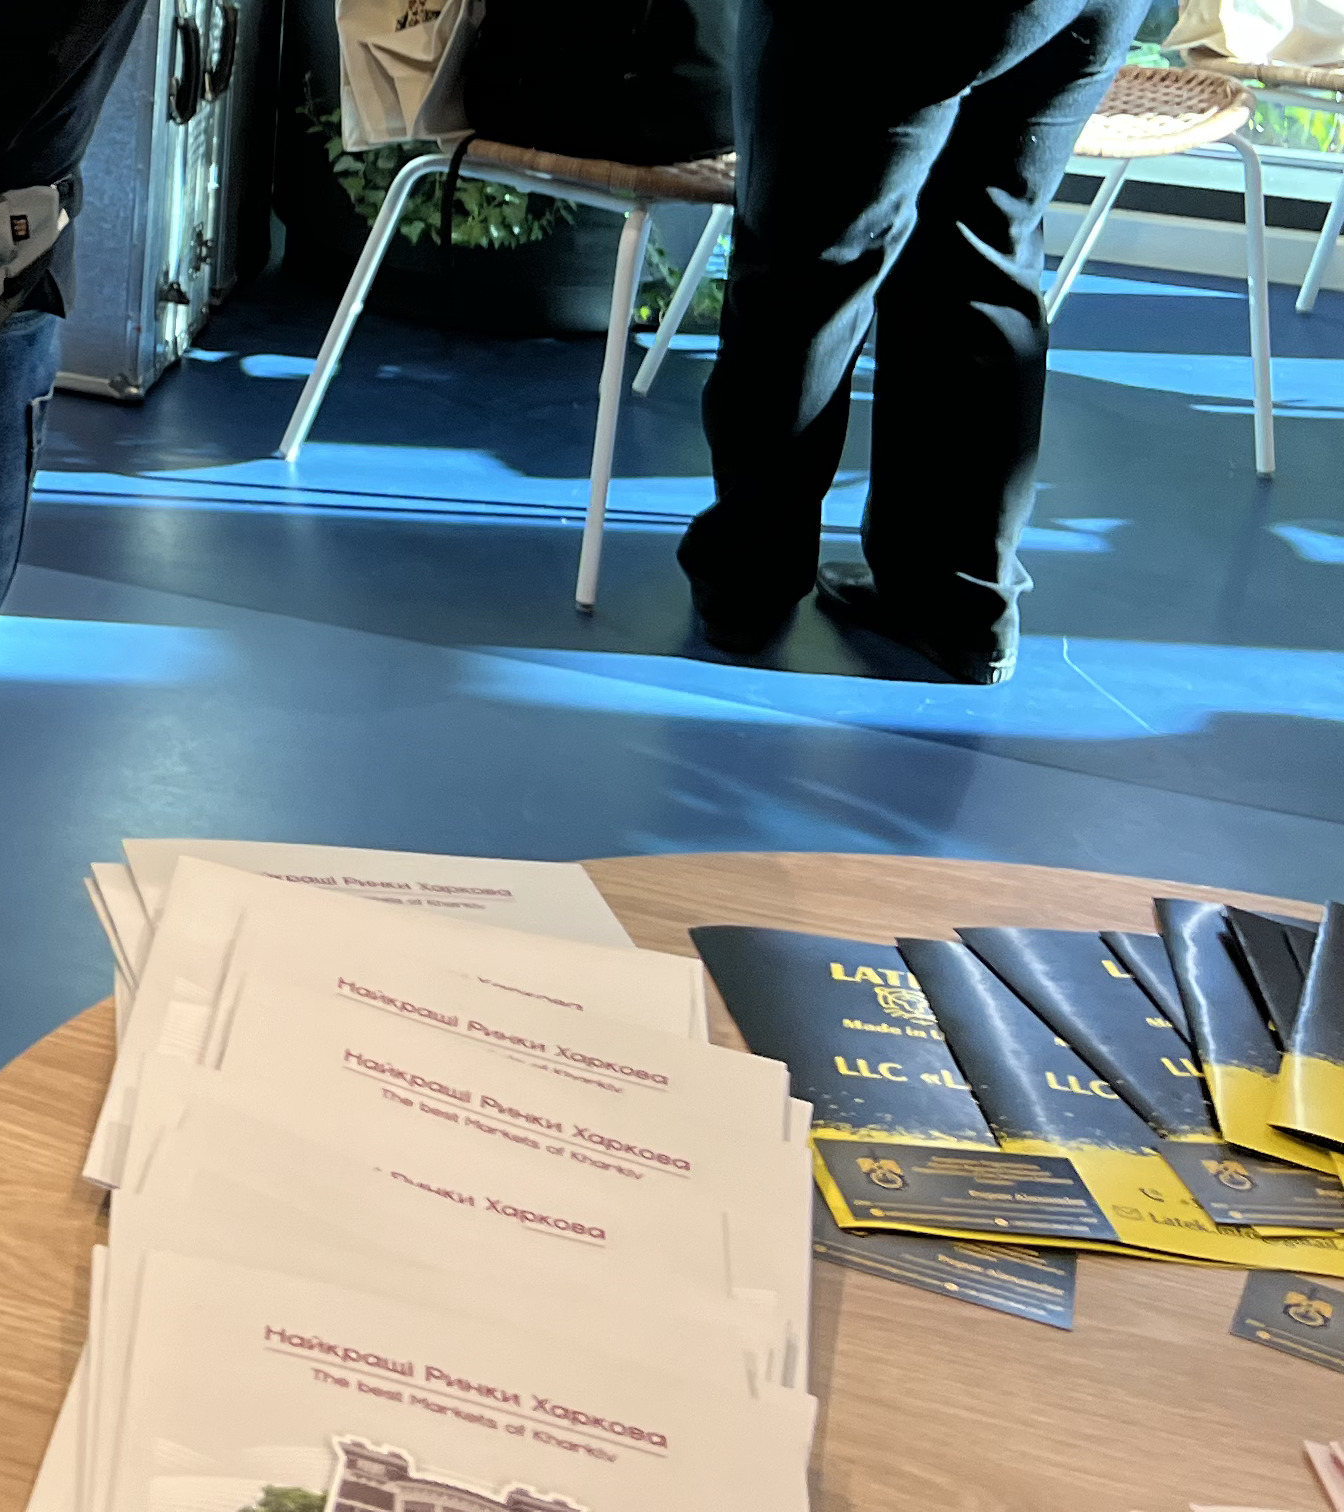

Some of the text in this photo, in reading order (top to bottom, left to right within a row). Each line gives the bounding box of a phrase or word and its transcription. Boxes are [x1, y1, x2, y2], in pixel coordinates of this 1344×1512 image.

[343, 876, 411, 891] Ринки
[417, 881, 512, 898] Харкова
[337, 976, 459, 1028] Найкращі
[467, 1019, 546, 1053] Ринки
[555, 1045, 669, 1086] Харкова
[834, 1056, 908, 1082] LLC
[842, 1019, 902, 1036] Made
[906, 1026, 927, 1039] in
[343, 1048, 691, 1171] Найкращі Ринки Харкова
[381, 1087, 644, 1180] The best Markets of Kharkiv
[485, 1196, 607, 1240] Харкова
[264, 1325, 669, 1449] Найкращі Ринки Харкова
[312, 1367, 618, 1463] The best Markets of Kharkiv
